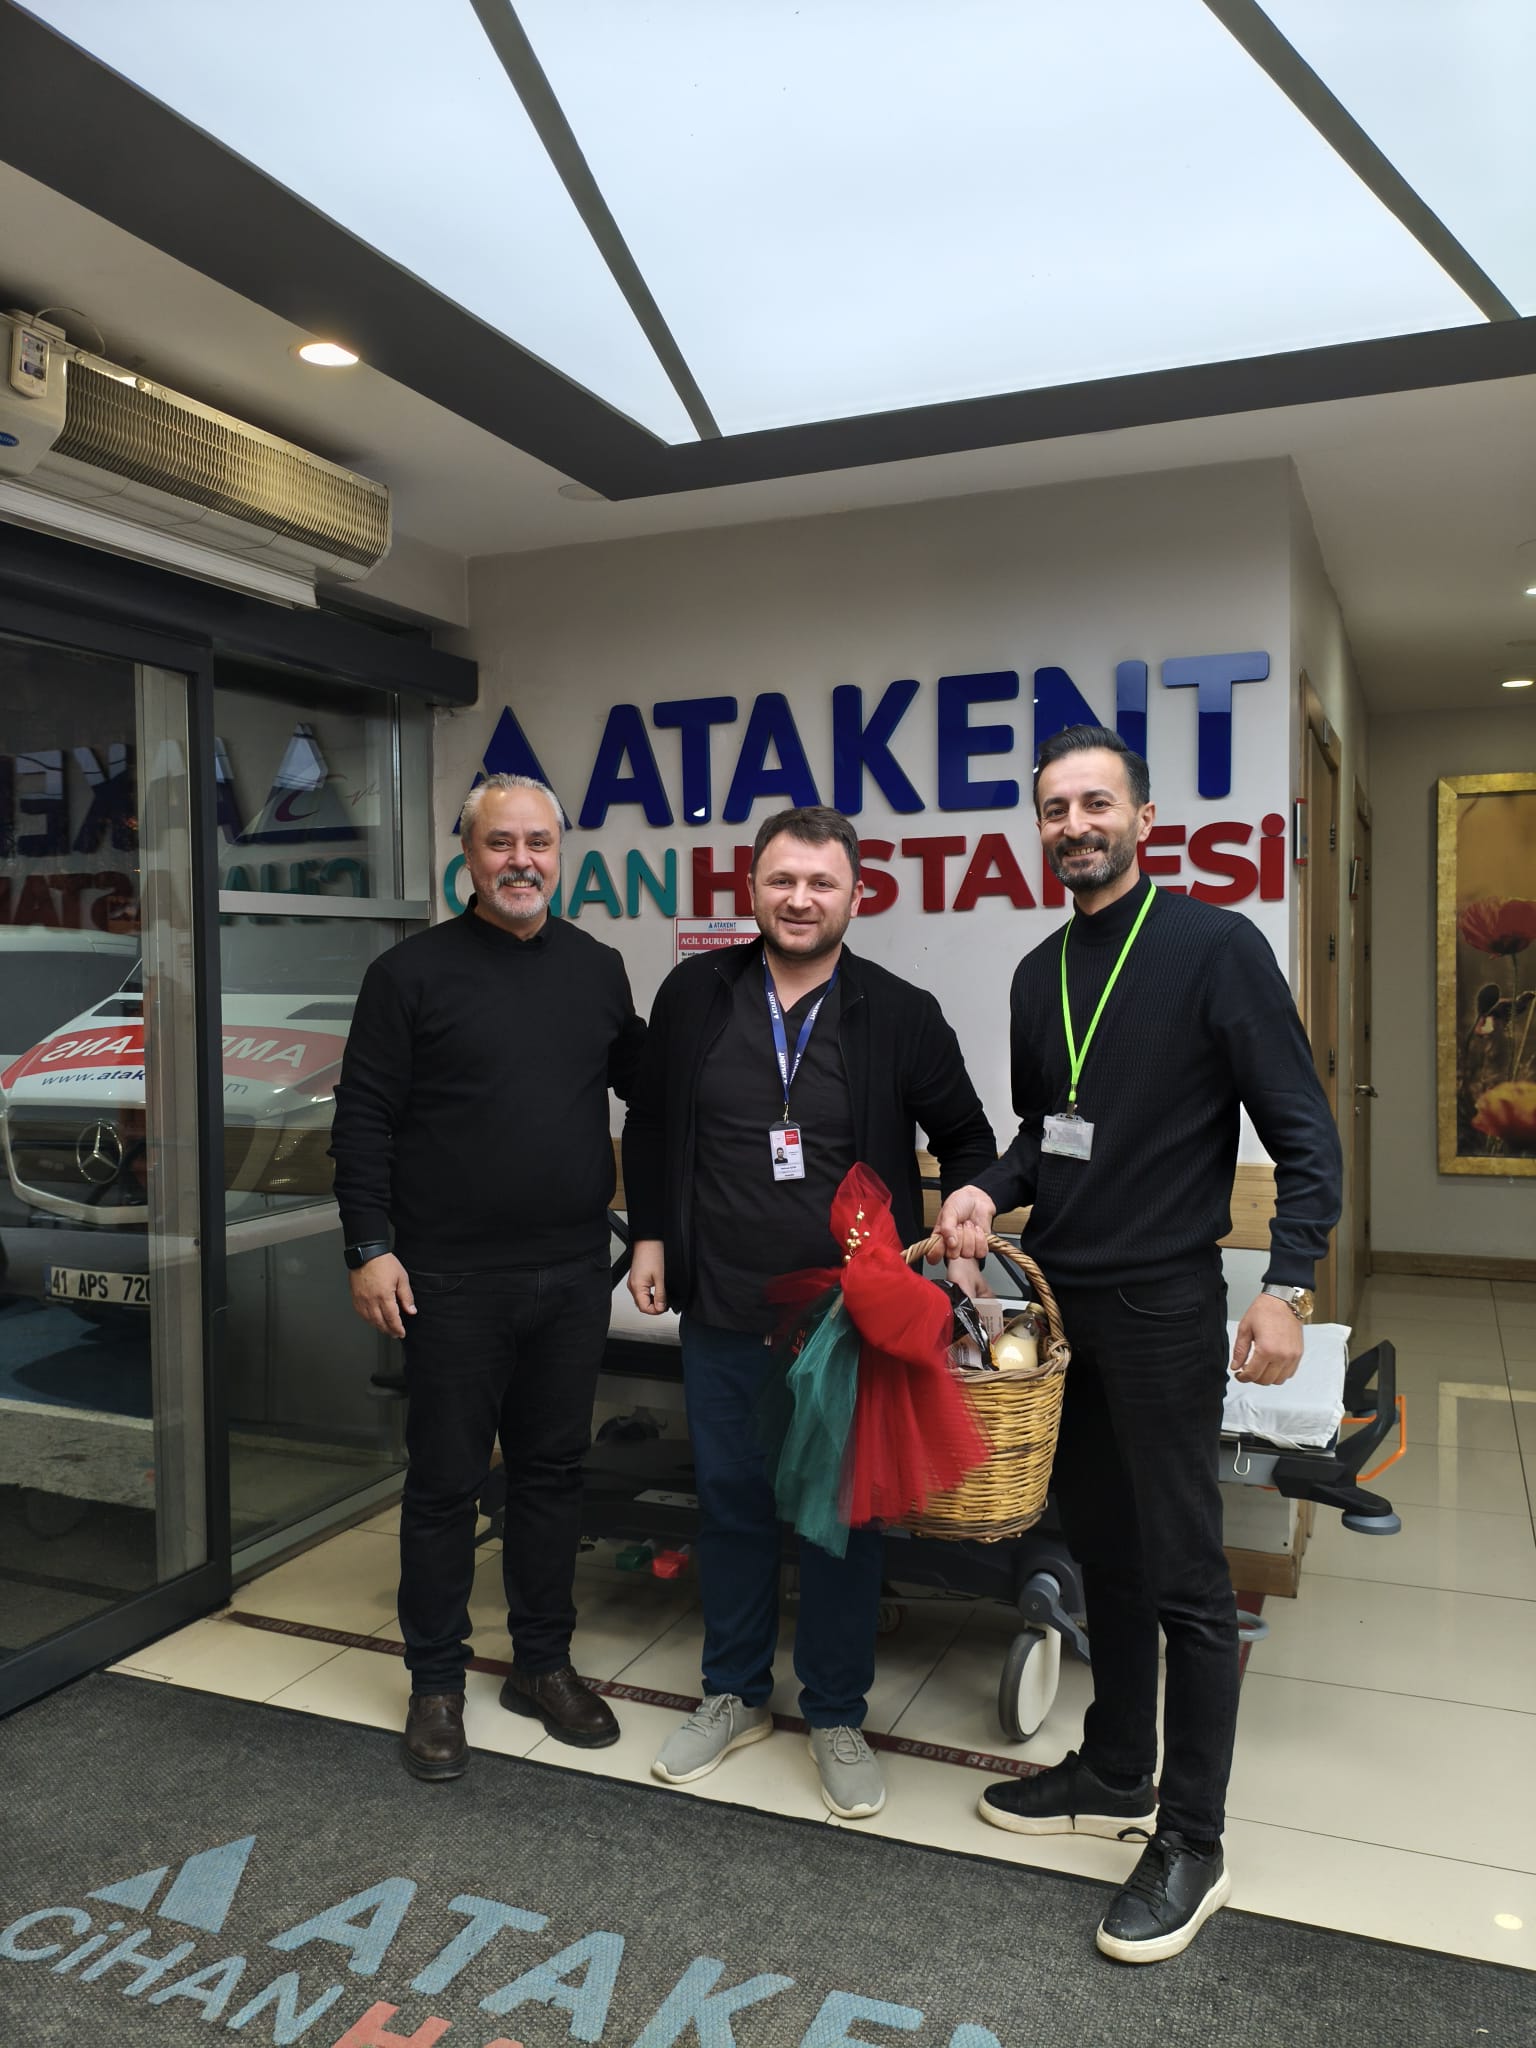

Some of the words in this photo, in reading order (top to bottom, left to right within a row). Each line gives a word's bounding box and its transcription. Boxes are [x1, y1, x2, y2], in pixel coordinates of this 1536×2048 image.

[577, 650, 1270, 829] ATAKENT
[702, 937, 732, 945] DURUM
[52, 1268, 68, 1295] 41
[78, 1272, 109, 1300] APS
[897, 1740, 961, 1763] SEDYE
[266, 1876, 1001, 2048] ATAKE
